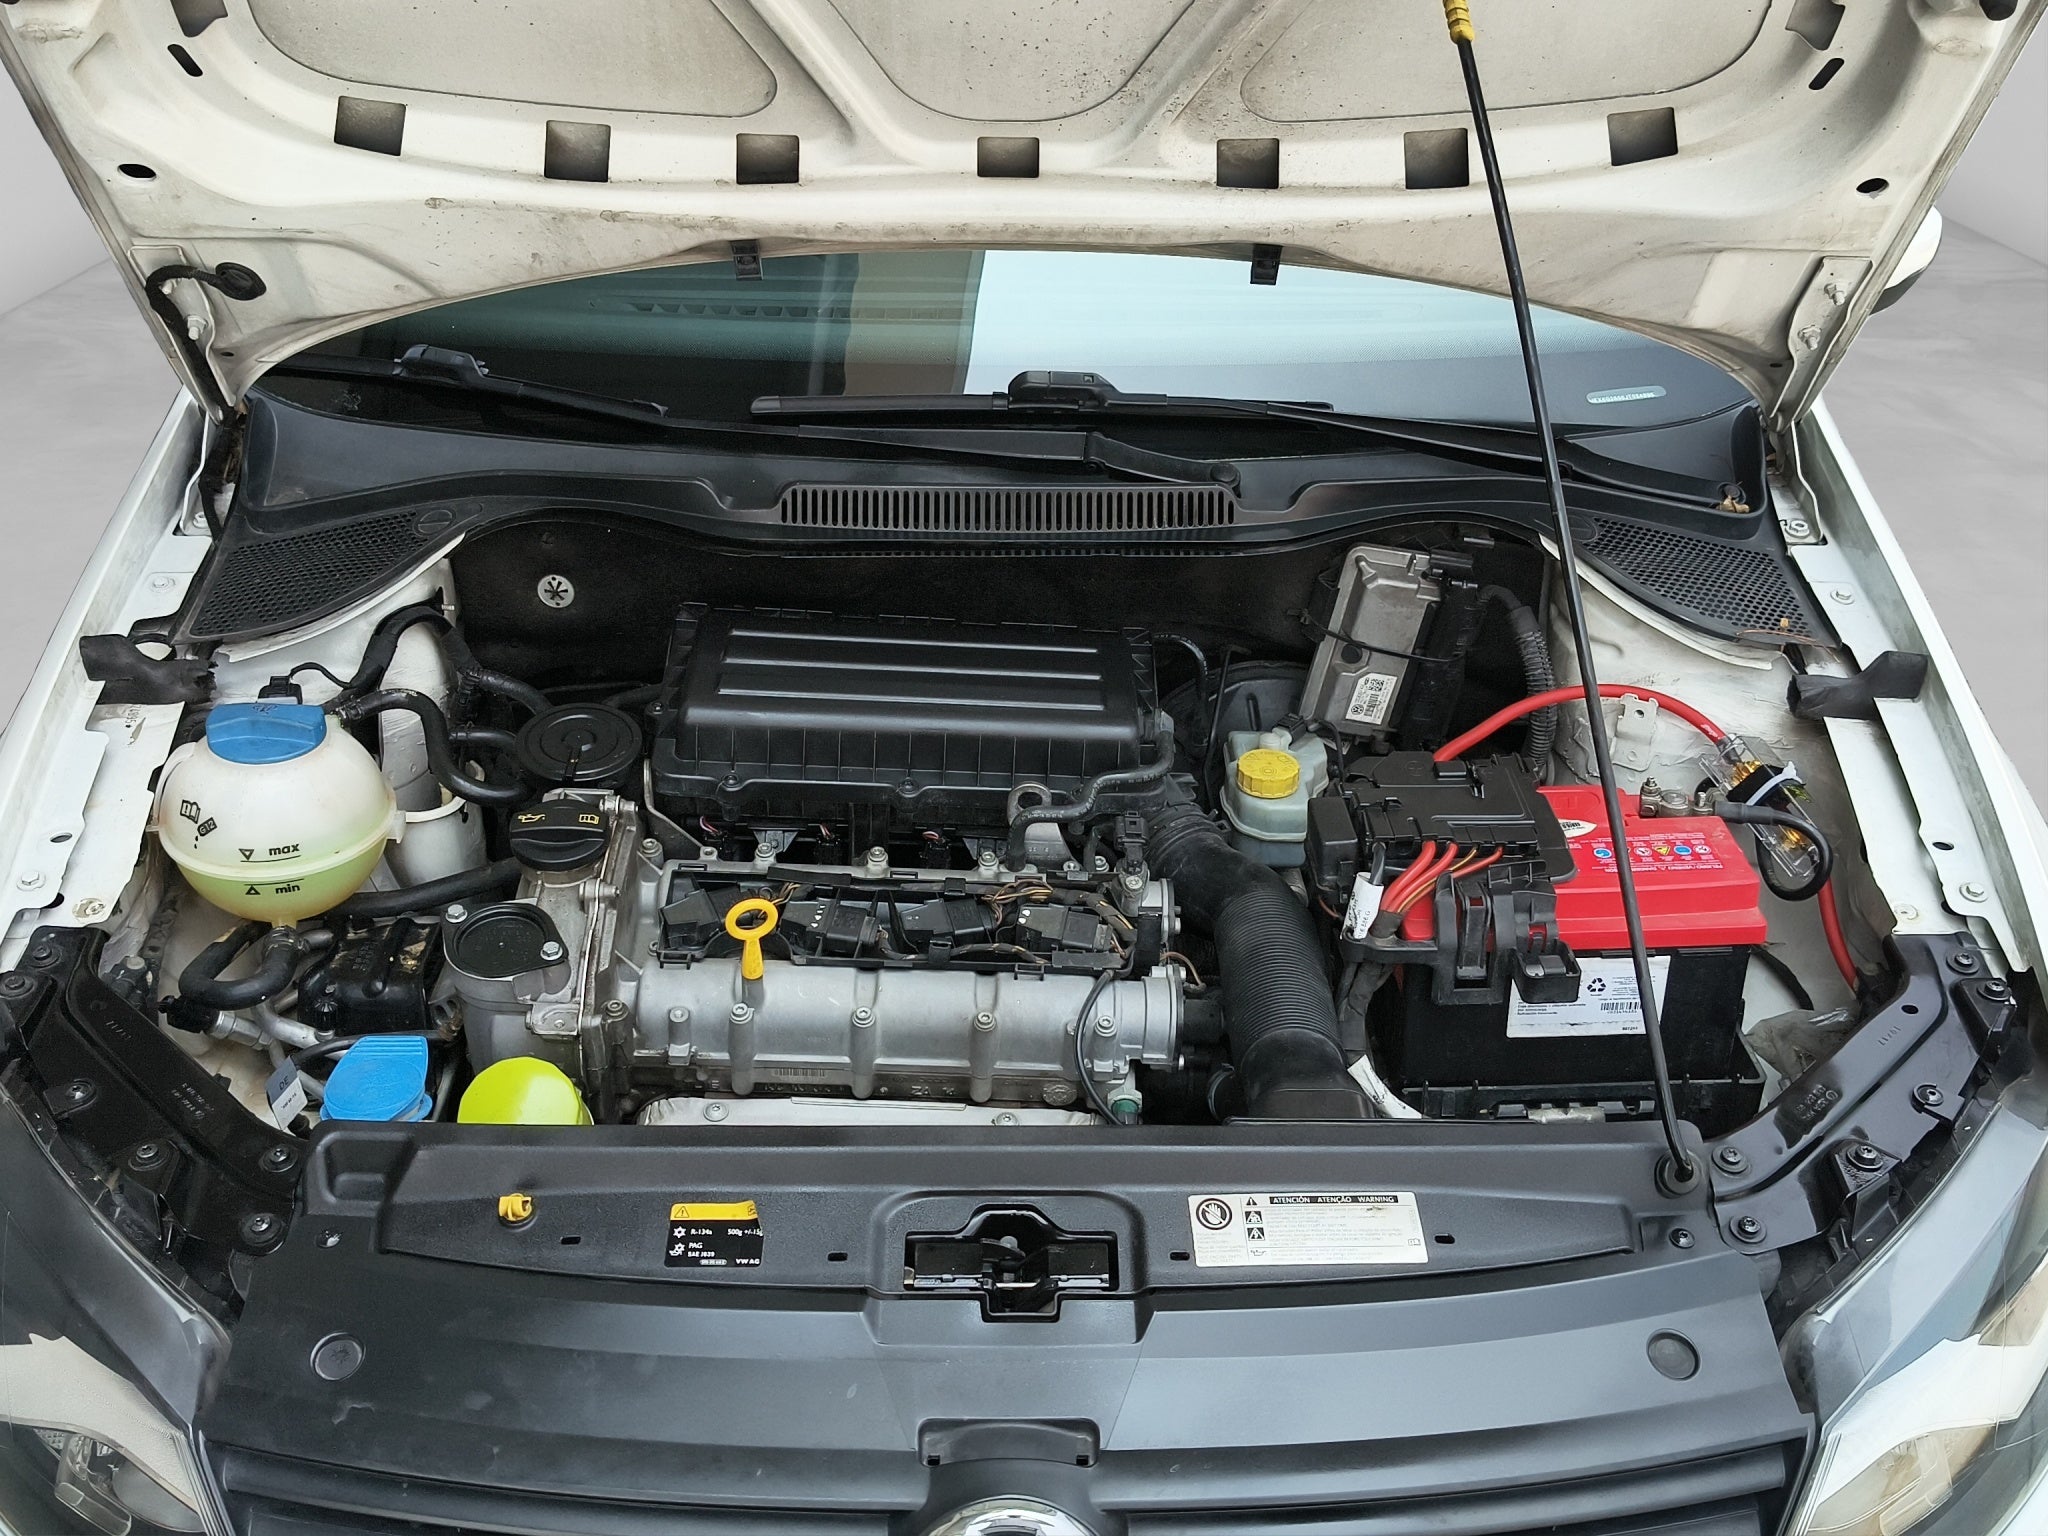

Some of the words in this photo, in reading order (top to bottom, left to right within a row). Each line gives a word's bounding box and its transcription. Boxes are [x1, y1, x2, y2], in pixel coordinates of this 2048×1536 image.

[199, 819, 215, 834] G12
[269, 843, 300, 856] max
[275, 883, 301, 895] min
[1273, 1195, 1311, 1204] ATENCIÓN
[1317, 1194, 1352, 1204] ATENÇÃO
[1357, 1195, 1395, 1203] WARNING
[690, 1228, 713, 1236] R-134a
